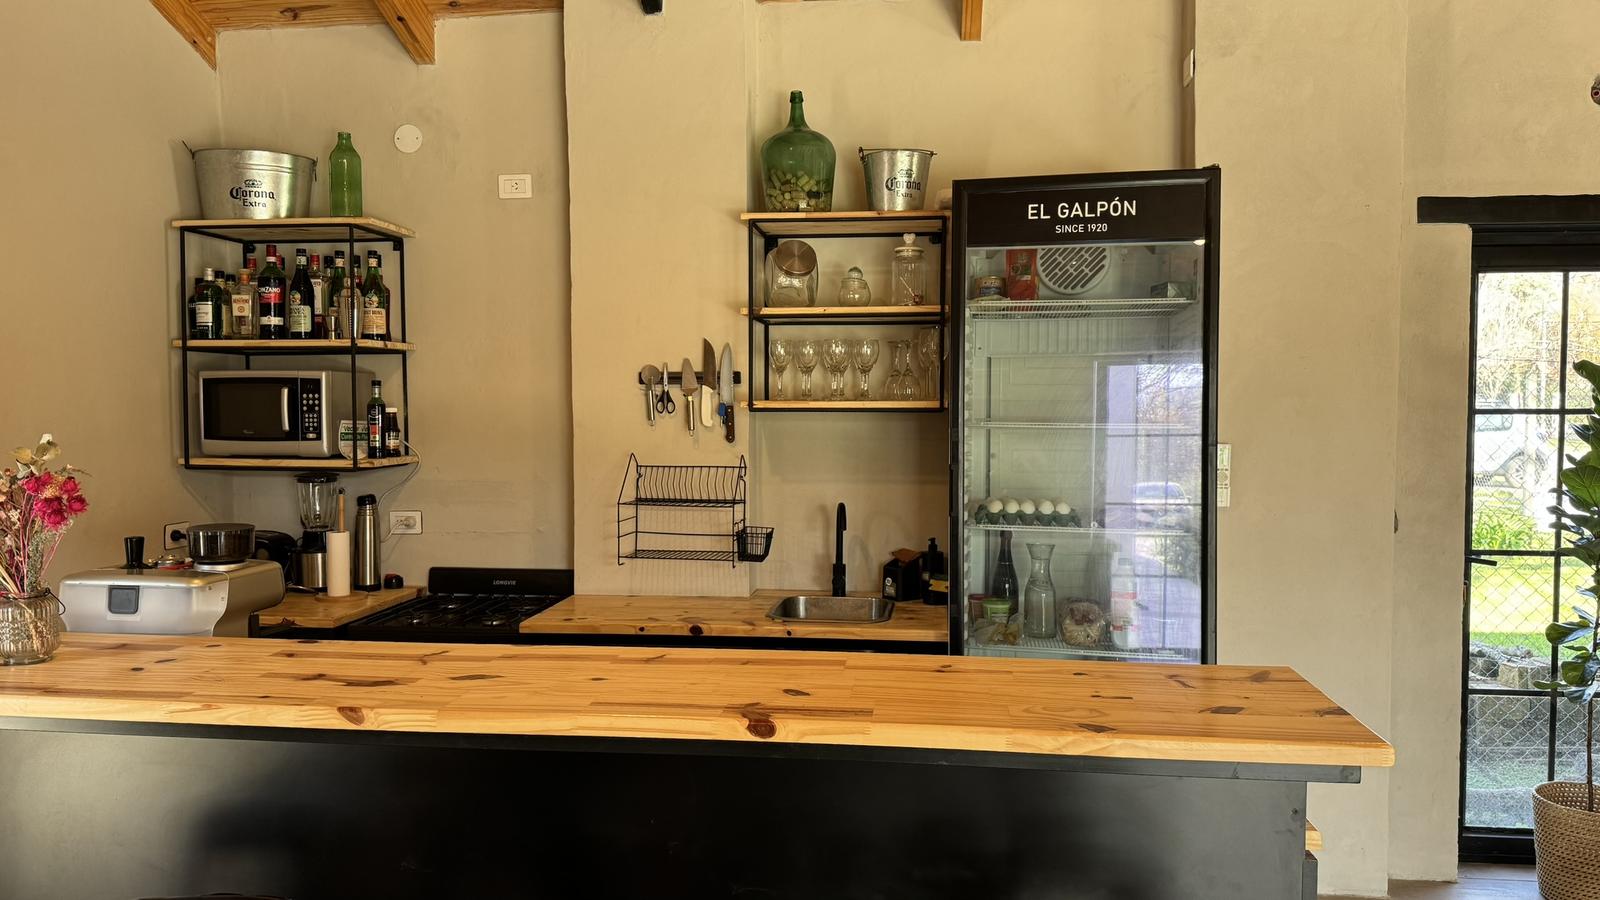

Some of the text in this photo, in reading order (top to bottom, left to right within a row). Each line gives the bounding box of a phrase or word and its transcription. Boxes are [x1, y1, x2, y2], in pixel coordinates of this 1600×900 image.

[885, 176, 921, 192] Corona
[229, 186, 276, 201] Corona
[242, 198, 267, 208] Extra
[1027, 196, 1137, 220] EL GALPÓN
[1055, 223, 1108, 234] SINCE 1920
